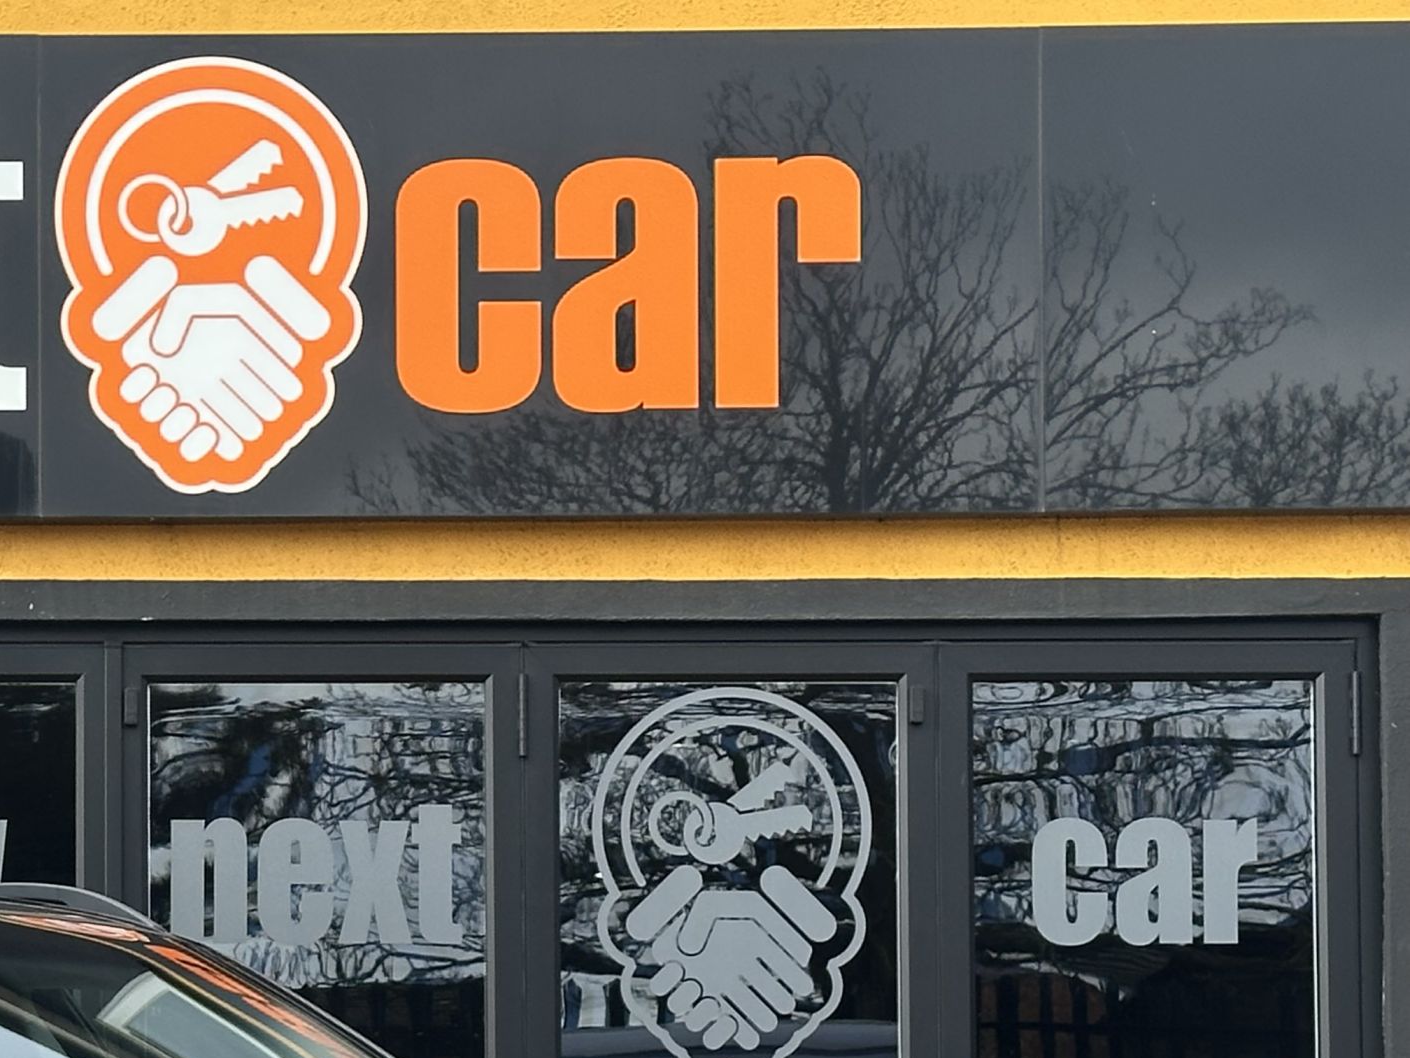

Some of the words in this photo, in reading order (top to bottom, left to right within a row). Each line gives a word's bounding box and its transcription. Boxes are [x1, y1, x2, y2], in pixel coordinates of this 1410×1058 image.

[396, 157, 859, 413] car
[170, 804, 465, 945] next
[1031, 817, 1259, 946] car
